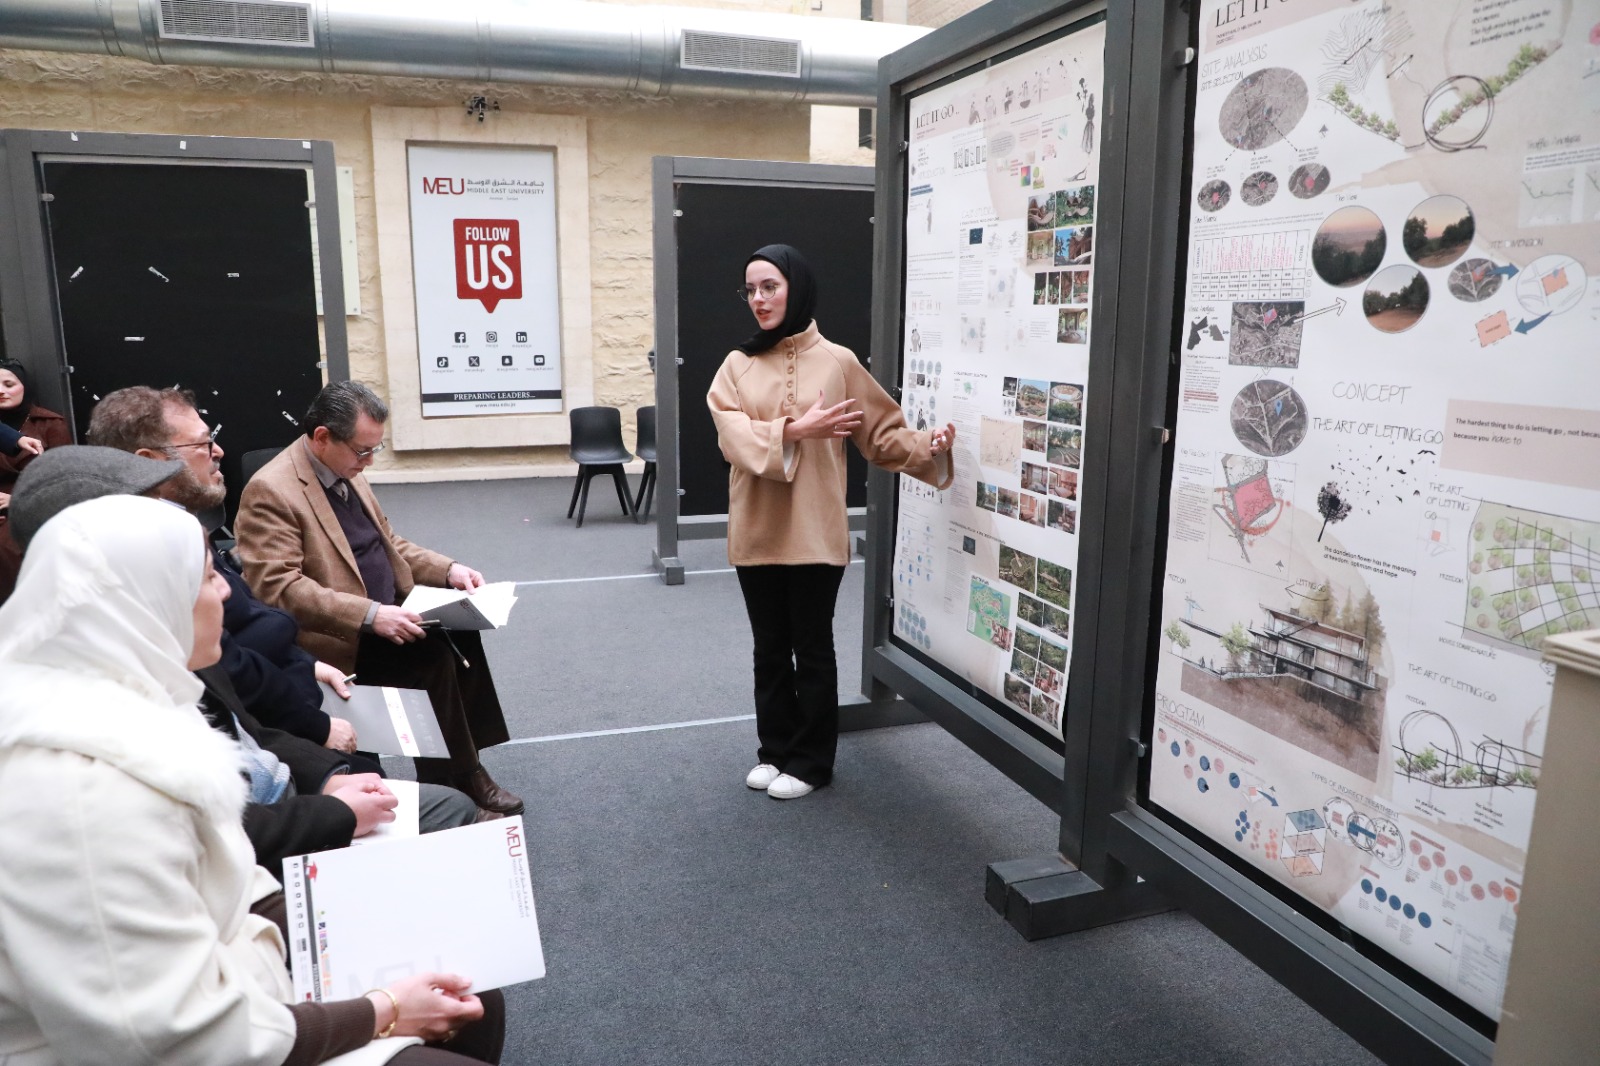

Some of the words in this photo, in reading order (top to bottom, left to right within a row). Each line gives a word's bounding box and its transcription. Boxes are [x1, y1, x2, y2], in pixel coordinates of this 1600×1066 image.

[1201, 59, 1221, 78] SITE
[1223, 44, 1269, 70] ANALYSIS
[940, 104, 954, 120] GO
[422, 176, 465, 195] MEU
[465, 226, 510, 241] FOLLOW
[465, 244, 514, 290] US
[454, 392, 496, 401] PREPARING
[1332, 381, 1412, 405] CONCEPT
[1313, 417, 1333, 431] THE
[1334, 420, 1357, 434] ART
[1358, 422, 1375, 435] OF
[1375, 424, 1422, 442] LETTING
[1423, 429, 1444, 445] GO
[1453, 431, 1477, 440] because
[1467, 419, 1491, 427] hardest
[1490, 421, 1506, 430] thing
[1515, 423, 1524, 431] do
[1531, 425, 1552, 435] letting
[1554, 428, 1563, 436] go
[1568, 429, 1580, 437] not
[1429, 481, 1445, 493] THE
[1446, 485, 1464, 496] ART
[1426, 495, 1438, 505] OF
[1438, 498, 1471, 512] LETTING
[1324, 545, 1333, 553] The
[1357, 554, 1372, 564] flower
[1372, 557, 1382, 566] has
[1382, 560, 1391, 569] the
[1391, 563, 1417, 577] meaning
[1350, 560, 1373, 572] optimism
[1372, 566, 1384, 575] and
[1384, 568, 1398, 578] hope
[1408, 662, 1423, 675] THE
[1423, 669, 1438, 681] ART
[1439, 675, 1451, 684] OF
[1451, 677, 1483, 699] LETTING
[1483, 690, 1497, 703] GO
[1311, 771, 1328, 784] TYPES
[1328, 779, 1336, 787] OF
[1337, 784, 1364, 801] INDIRECT
[1364, 796, 1399, 819] TREATMENT
[505, 825, 523, 858] MEU
